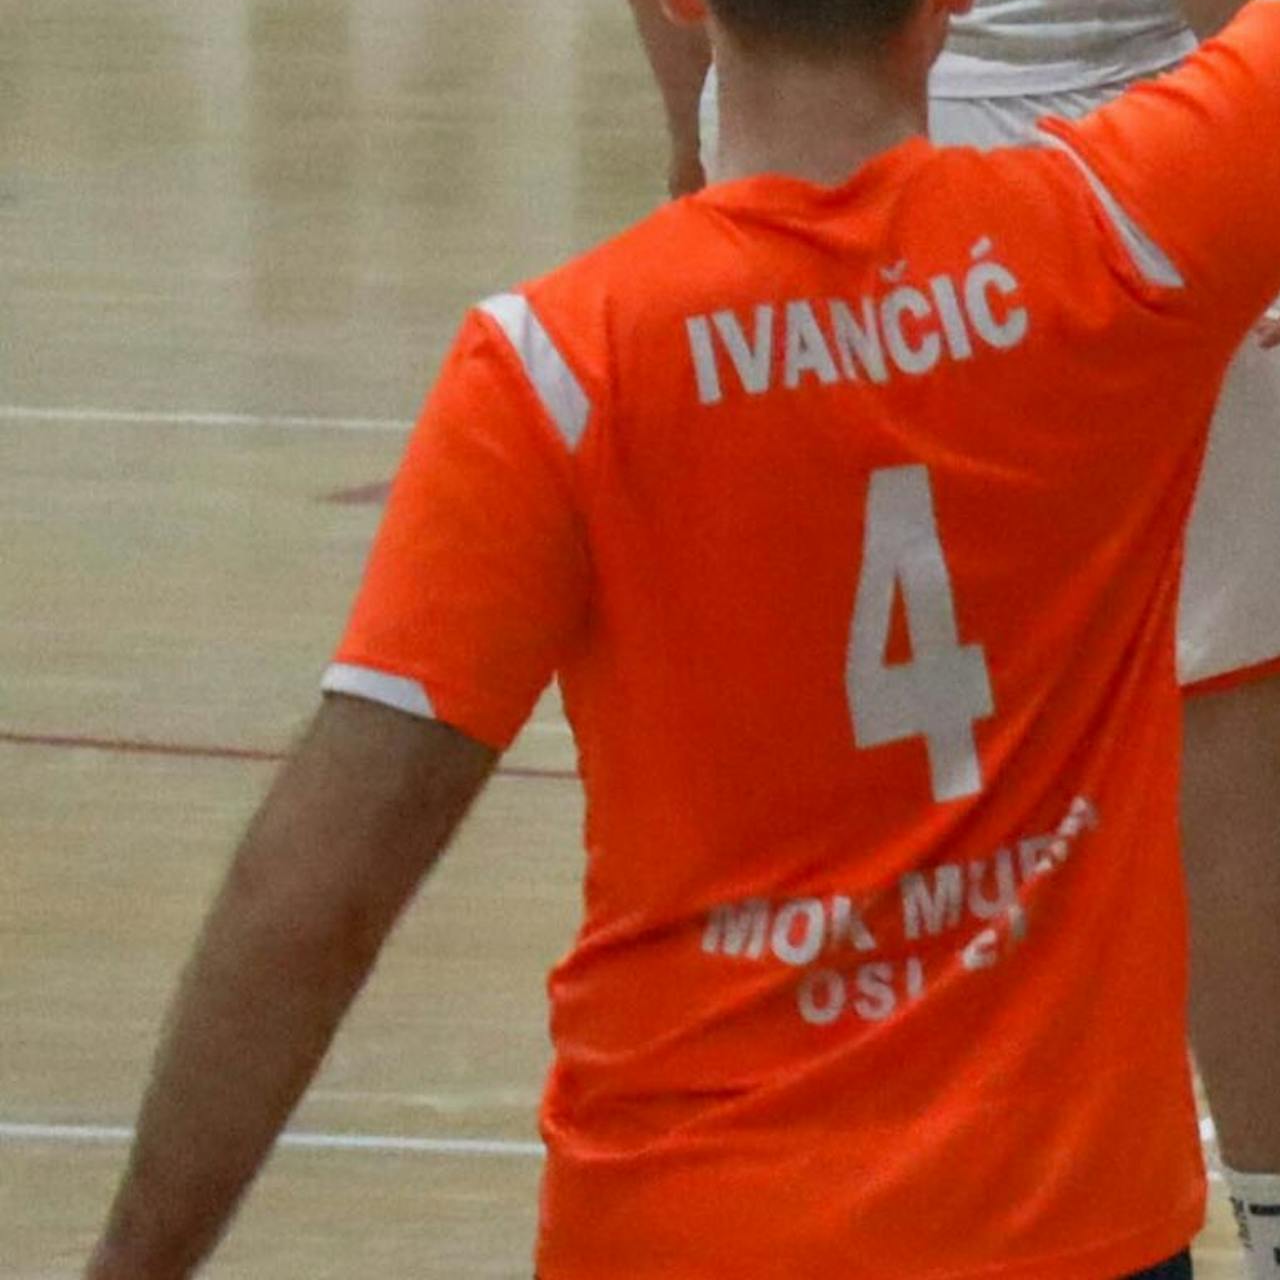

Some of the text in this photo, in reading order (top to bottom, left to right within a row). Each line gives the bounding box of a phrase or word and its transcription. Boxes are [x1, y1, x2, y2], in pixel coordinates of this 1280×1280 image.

[685, 235, 1028, 406] IVANČIĆ
[845, 463, 995, 804] 4
[702, 894, 877, 967] MOK
